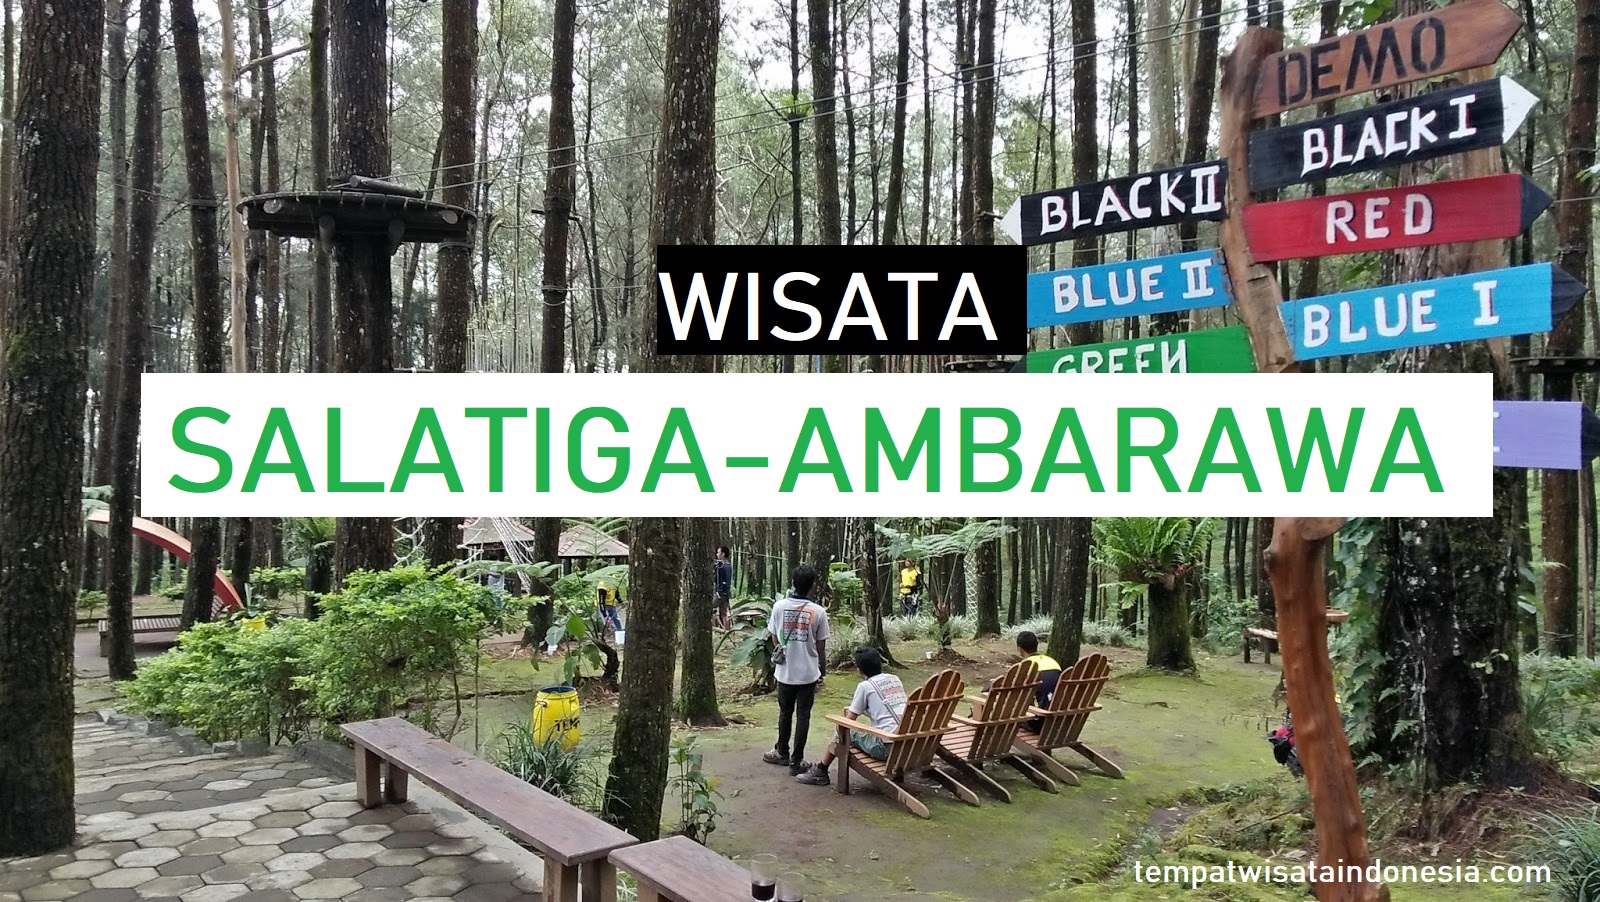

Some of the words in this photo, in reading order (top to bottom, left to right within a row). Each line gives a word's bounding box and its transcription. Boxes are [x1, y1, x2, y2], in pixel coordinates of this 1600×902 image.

[1279, 18, 1446, 105] DEMO
[1301, 107, 1439, 176] BLACK
[1449, 94, 1477, 140] I
[1040, 171, 1185, 236] BLACK
[1191, 165, 1222, 215] II
[1325, 193, 1433, 244] RED
[1053, 265, 1165, 314] BLUE
[1181, 258, 1215, 299] II
[1303, 289, 1436, 348] BLUE
[1473, 280, 1499, 326] I
